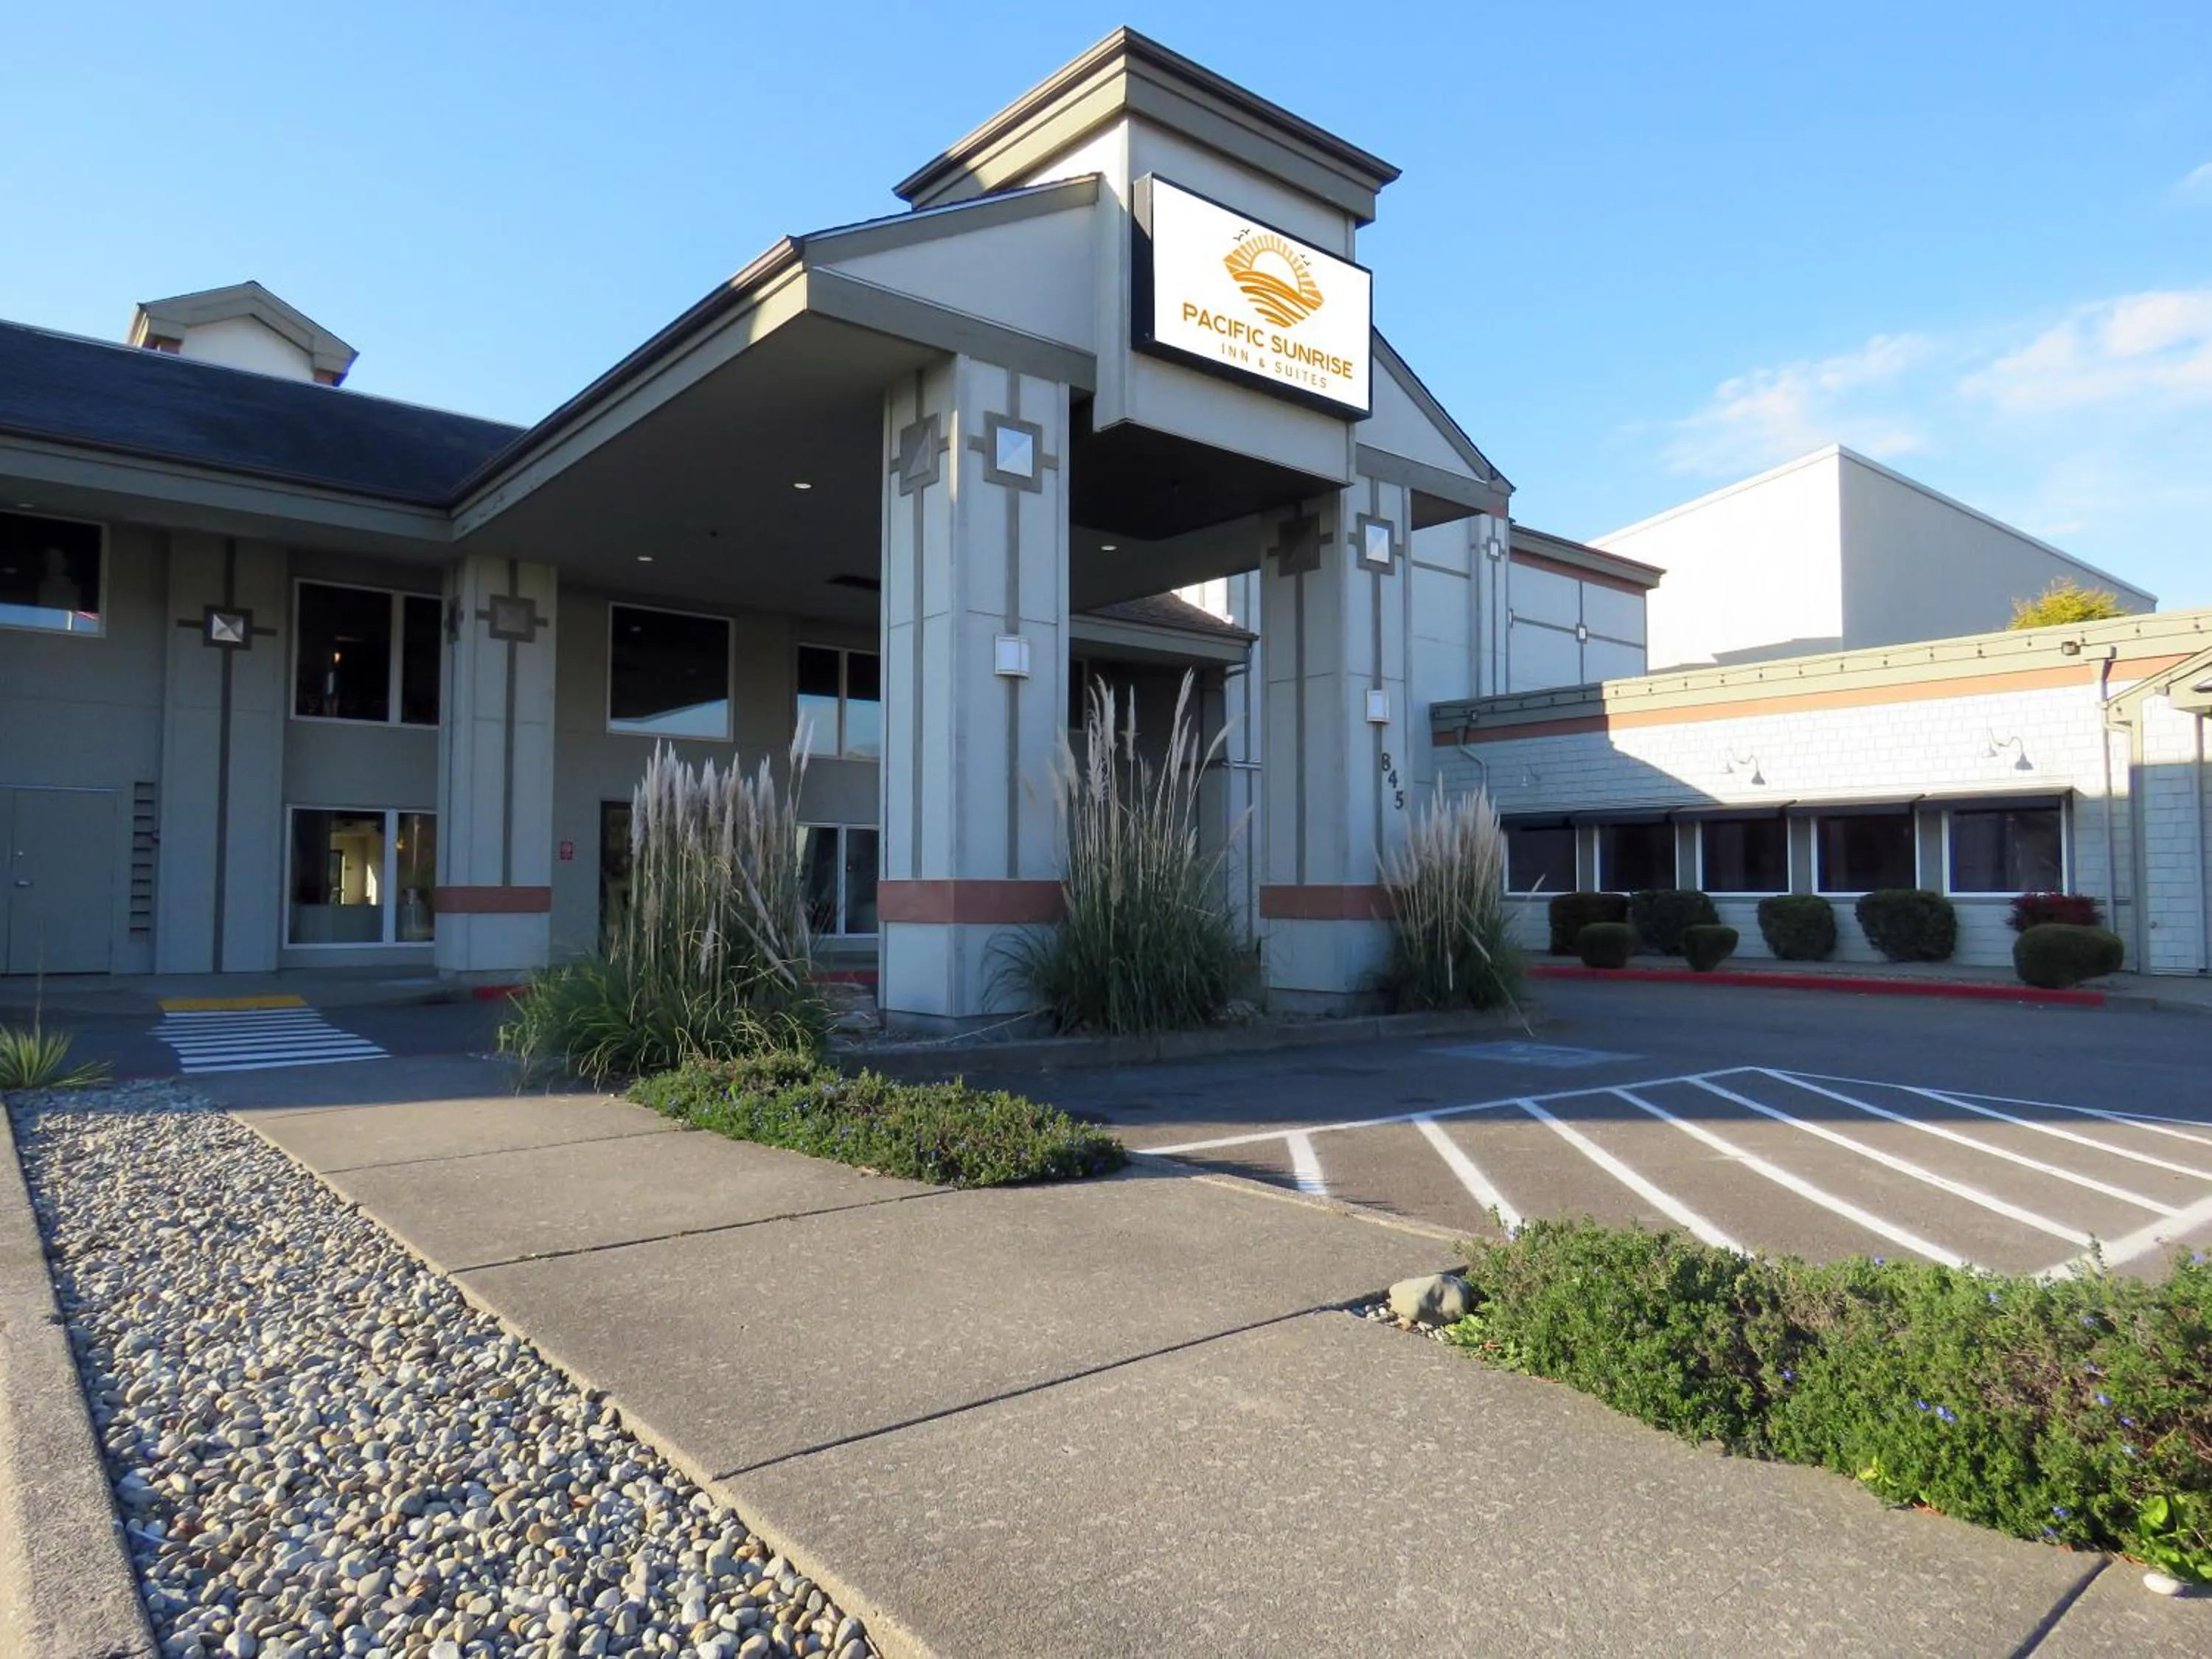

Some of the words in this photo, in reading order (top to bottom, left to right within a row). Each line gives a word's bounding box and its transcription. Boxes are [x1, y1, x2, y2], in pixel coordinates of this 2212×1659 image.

[1183, 302, 1265, 347] PACIFIC
[1271, 335, 1353, 379] SUNRISE
[1222, 343, 1248, 363] INN
[1259, 358, 1266, 368] &
[1275, 361, 1327, 388] SUITES
[1381, 752, 1404, 810] 845
